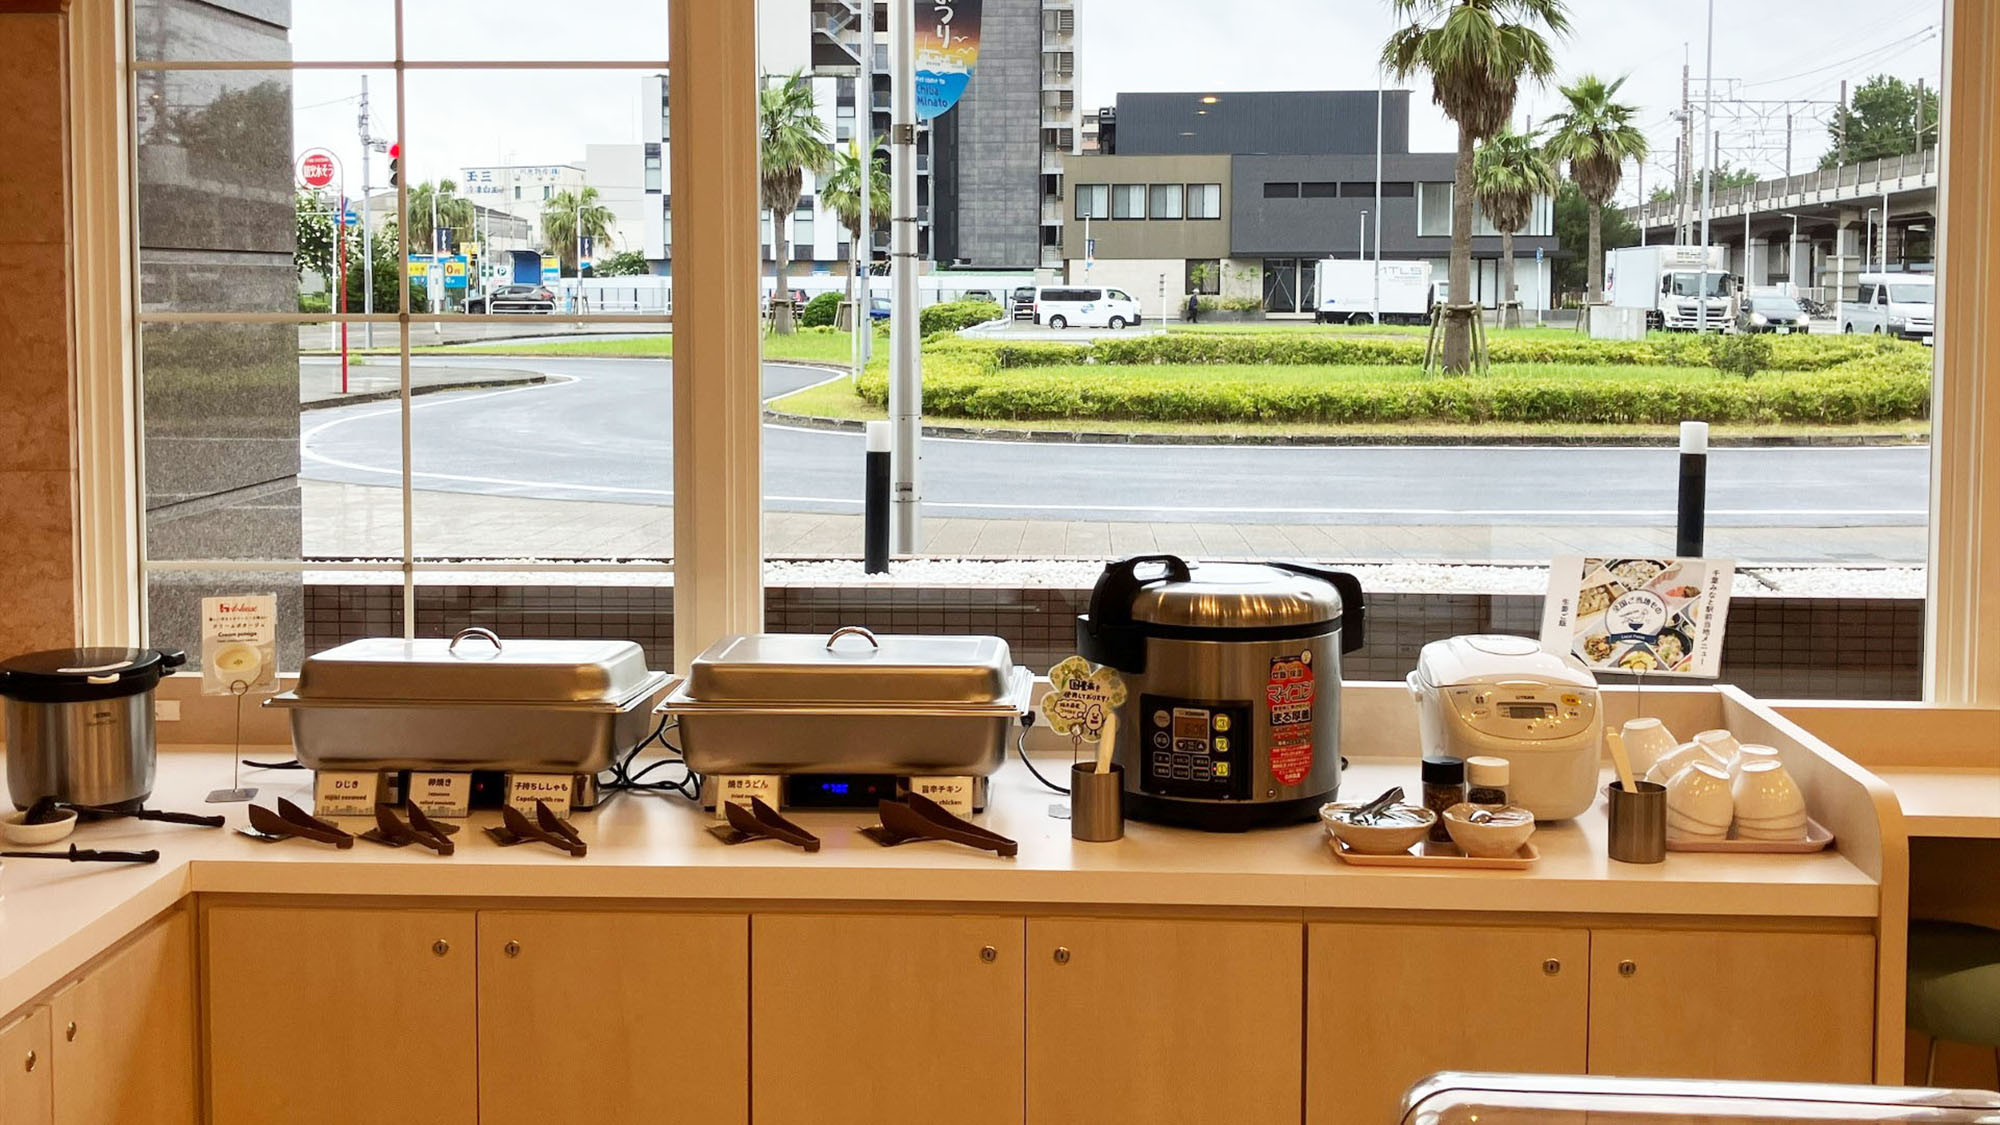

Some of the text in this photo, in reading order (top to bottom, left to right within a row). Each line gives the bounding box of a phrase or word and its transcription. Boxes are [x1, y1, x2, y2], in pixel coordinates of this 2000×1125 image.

[934, 0, 954, 48] つり
[335, 780, 359, 789] ひじき
[515, 782, 568, 791] 子持ちししゃも
[728, 779, 769, 789] 焼きうどん
